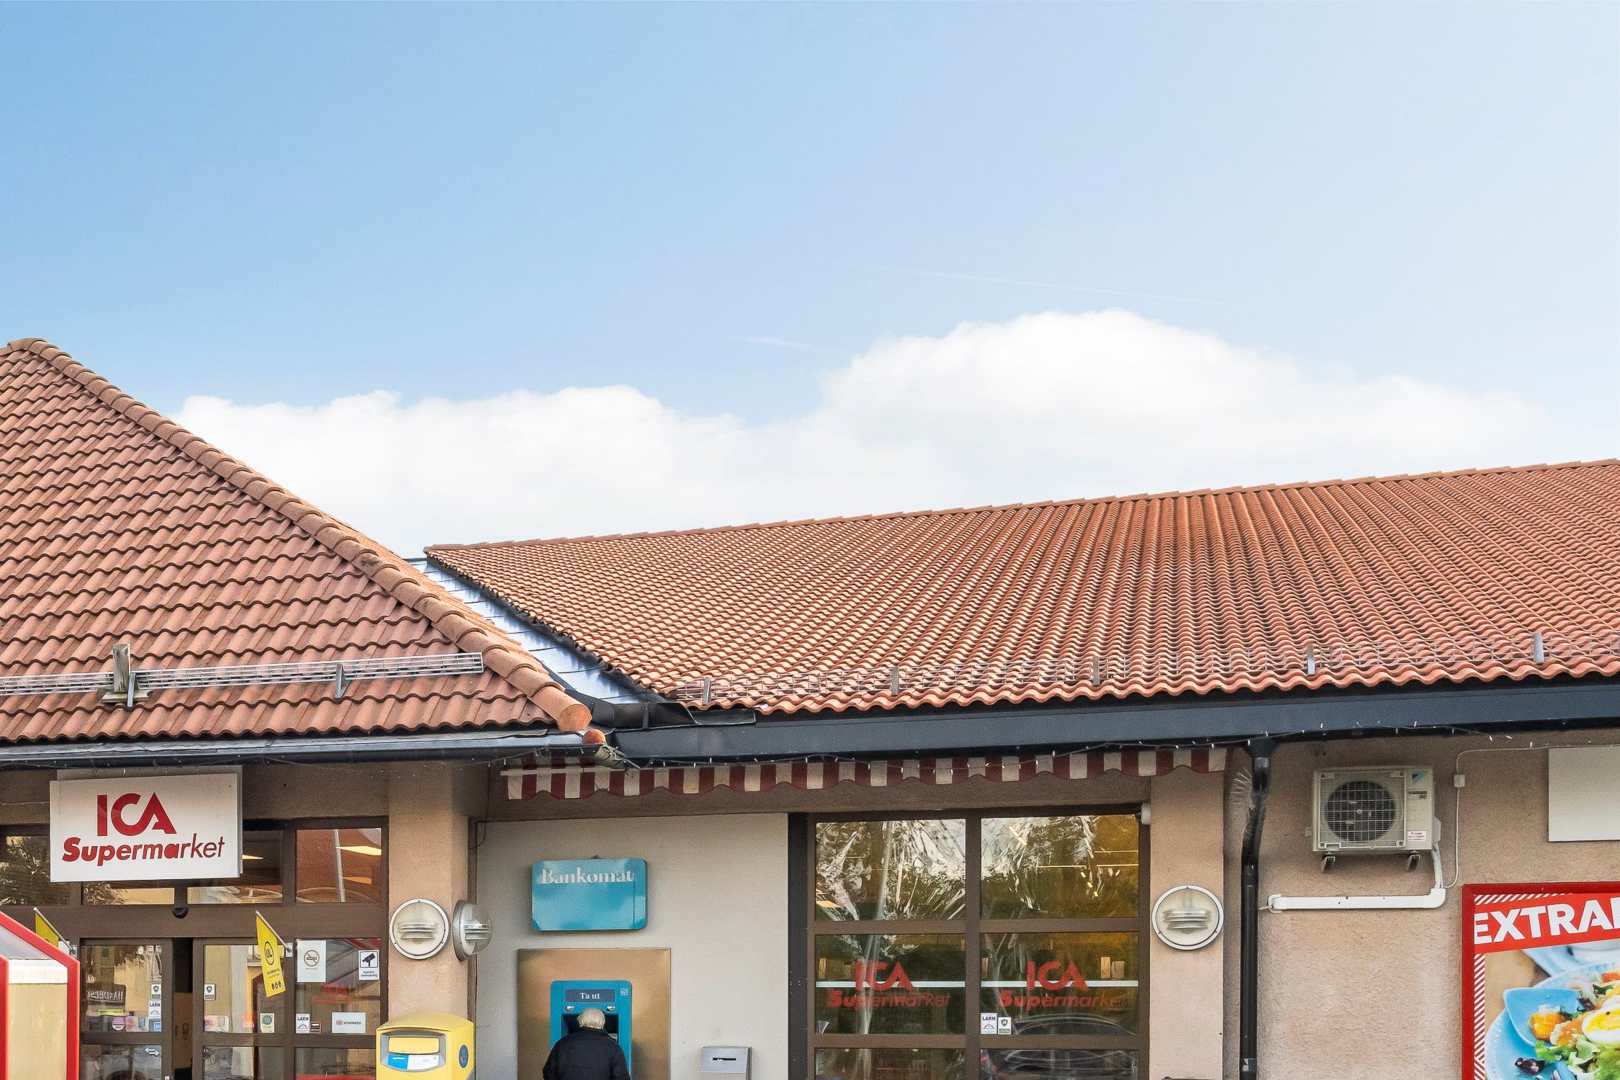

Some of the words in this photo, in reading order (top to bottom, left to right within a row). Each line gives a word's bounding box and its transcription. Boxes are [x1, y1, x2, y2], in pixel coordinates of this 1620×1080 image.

[97, 791, 177, 836] ICA
[62, 833, 226, 866] Supermarket
[540, 866, 635, 884] Bankomat
[855, 961, 915, 991] ICA
[1027, 960, 1089, 991] ICA
[828, 989, 951, 1011] Supermarket
